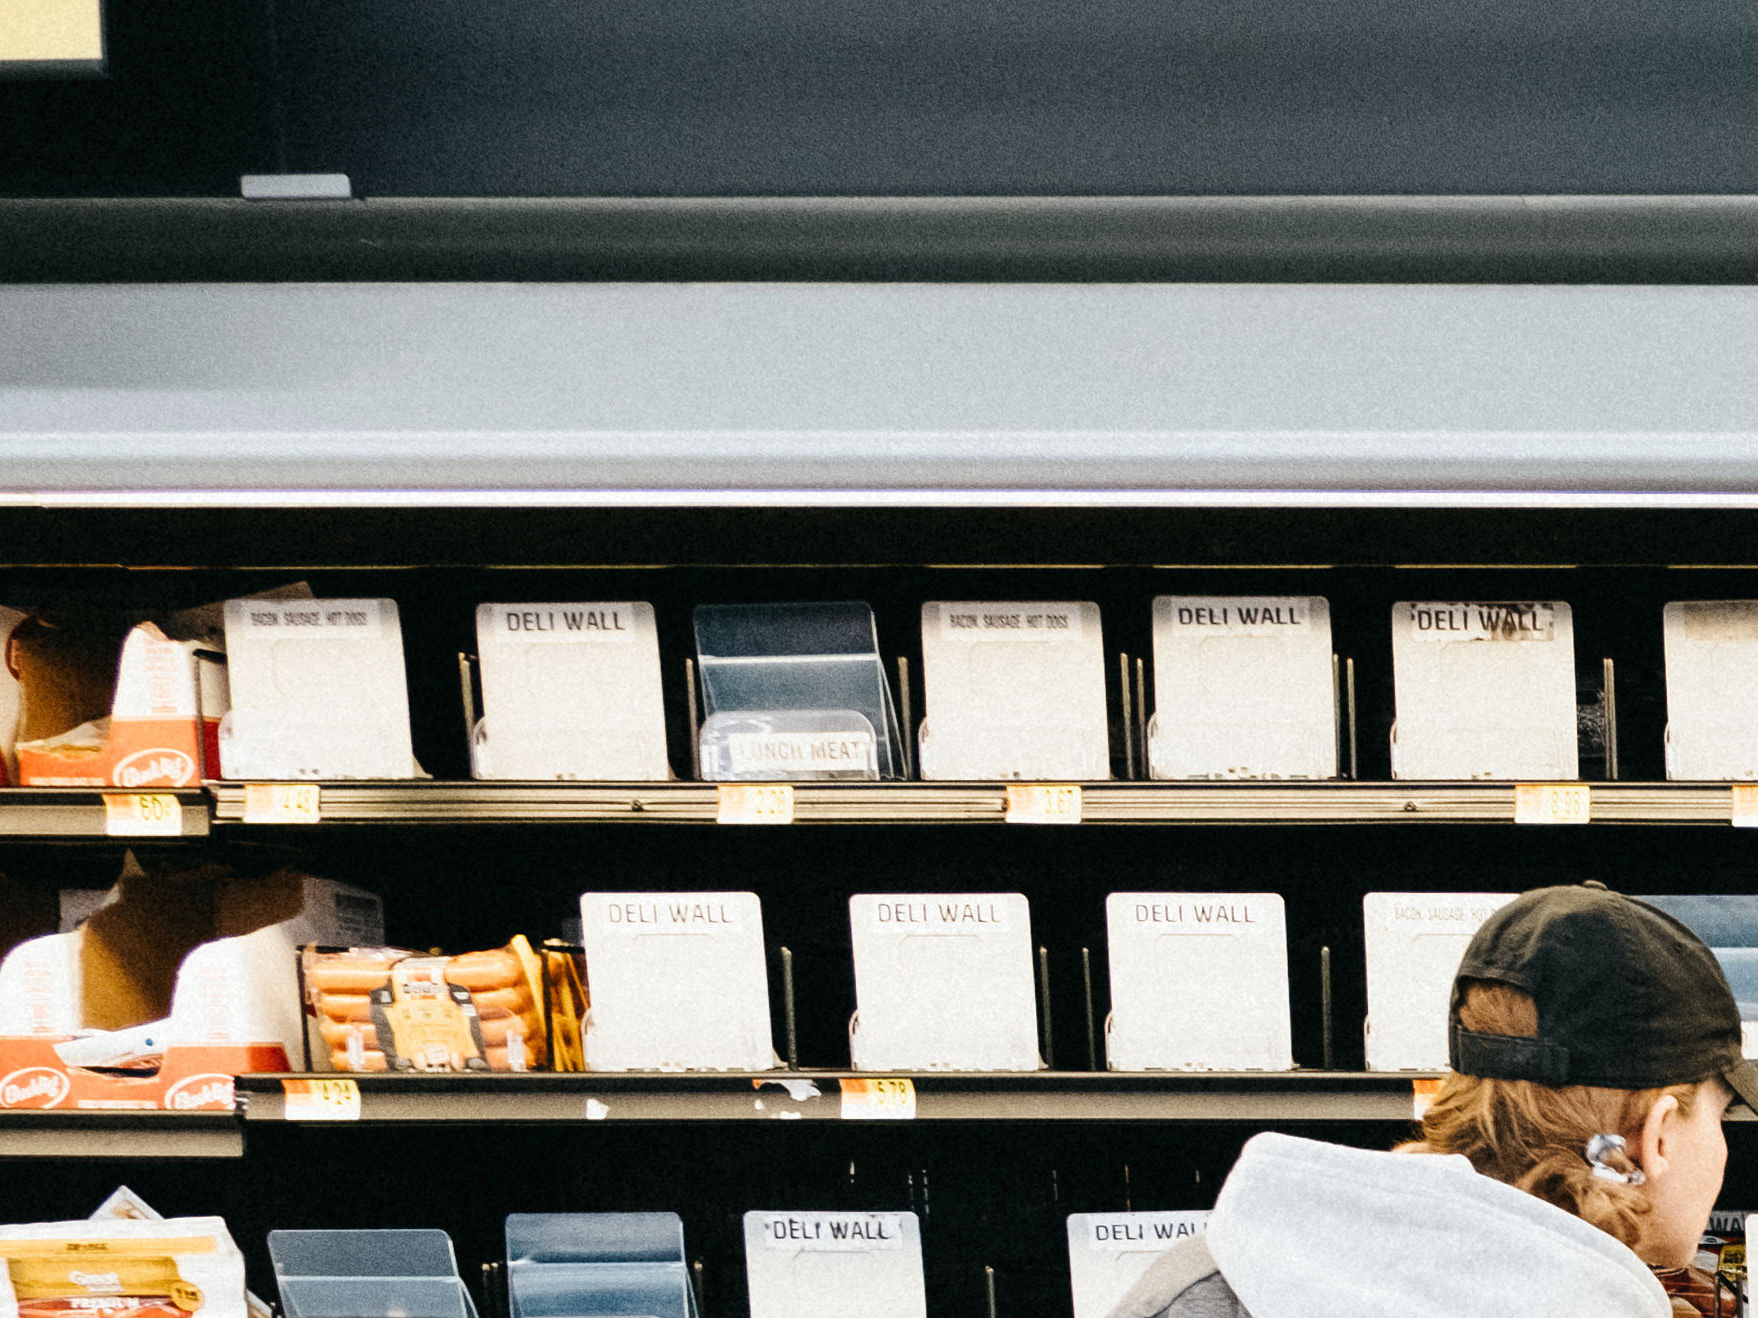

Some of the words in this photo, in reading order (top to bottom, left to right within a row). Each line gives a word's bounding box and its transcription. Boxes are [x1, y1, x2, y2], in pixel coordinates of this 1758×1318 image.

[505, 611, 555, 632] DELI
[562, 610, 625, 631] WALL
[1177, 606, 1229, 626] DELI
[1236, 606, 1301, 626] WALL
[1416, 607, 1470, 631] DELI
[1478, 607, 1546, 633] WALL
[608, 903, 658, 924] DELI
[667, 903, 732, 924] WALL
[877, 902, 928, 923] DELI
[937, 903, 1001, 924] WALL
[1135, 904, 1184, 923] DELI
[1193, 904, 1256, 924] WALL
[772, 1217, 822, 1240] DELI
[829, 1216, 892, 1241] WALL
